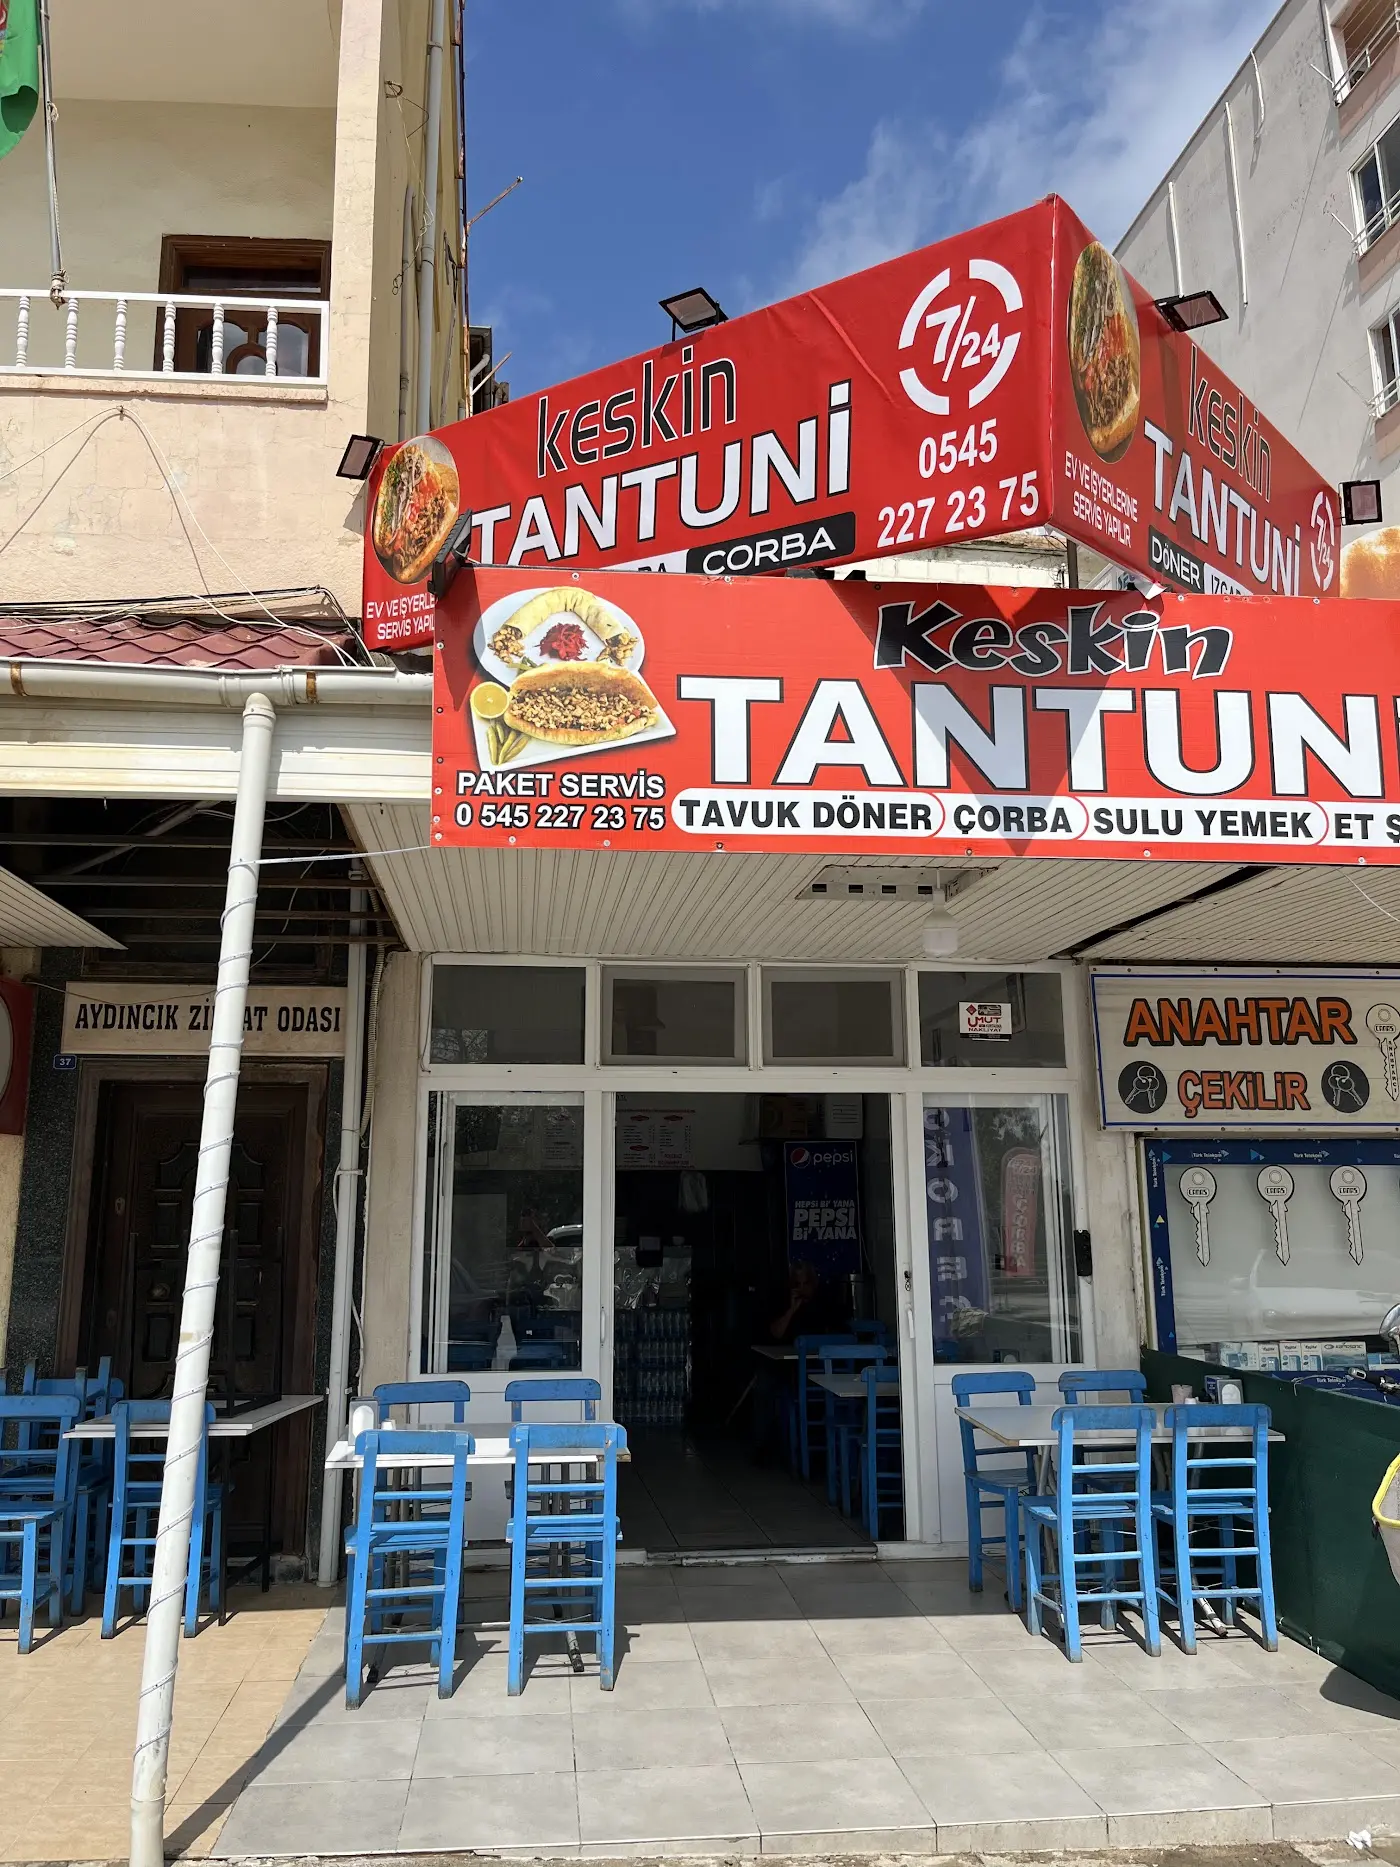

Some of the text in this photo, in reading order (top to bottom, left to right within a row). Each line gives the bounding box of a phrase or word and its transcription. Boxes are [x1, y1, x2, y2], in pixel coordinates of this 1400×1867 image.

[926, 295, 1001, 383] 7/24
[536, 346, 738, 478] keskin
[918, 417, 998, 480] 0545
[1065, 450, 1078, 480] EV
[1079, 460, 1090, 491] VE
[878, 471, 1039, 548] 227 23 75
[1151, 534, 1202, 591] DÖNER
[366, 592, 436, 619] EV VE İŞYERLE
[412, 613, 436, 635] YAPIL
[873, 600, 1234, 680] Keskin
[677, 673, 1400, 799] TANTUN
[456, 770, 554, 798] PAKET
[537, 803, 585, 829] 227
[591, 804, 626, 830] 23
[633, 804, 667, 831] 75
[680, 795, 933, 831] TAVUK DÖNER
[953, 803, 1073, 835] ÇORBA
[1093, 807, 1314, 839] SULU YEMEK
[1334, 813, 1374, 840] ET
[75, 996, 341, 1032] AYDINCIK ZİAT ODASI
[967, 1016, 1002, 1028] UMUT
[1123, 996, 1358, 1047] ANAHTAR
[59, 1057, 72, 1066] 37
[813, 1149, 853, 1166] pepsi
[794, 1207, 855, 1228] PEPSI
[833, 1199, 855, 1208] YANA
[815, 1226, 857, 1240] YANA
